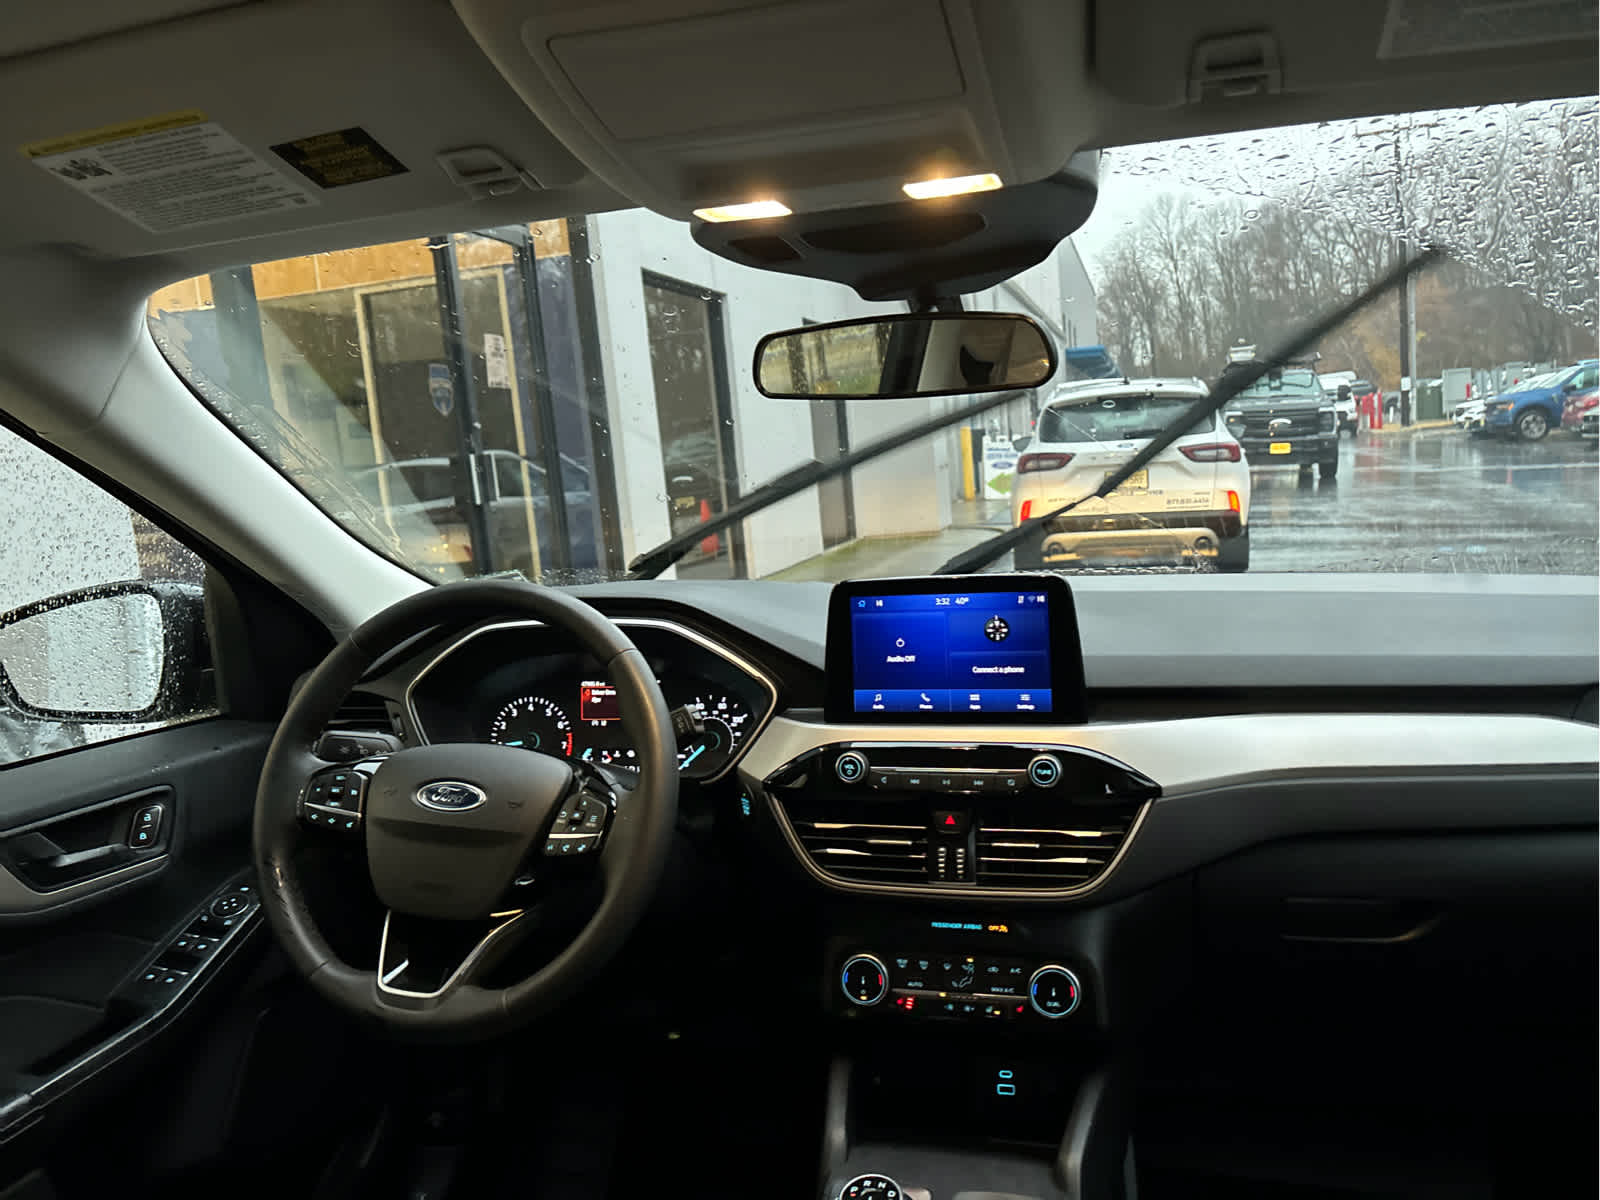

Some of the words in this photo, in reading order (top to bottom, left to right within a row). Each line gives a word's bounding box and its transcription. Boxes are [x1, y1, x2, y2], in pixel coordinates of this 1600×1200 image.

[935, 597, 950, 606] 3:32
[886, 655, 904, 663] Audio
[904, 655, 916, 663] Off
[972, 665, 998, 674] Connect
[1004, 665, 1025, 675] phone
[527, 703, 534, 712] 4
[511, 708, 518, 717] 3
[545, 708, 552, 717] 5
[500, 721, 507, 730] 2
[557, 720, 564, 730] 6
[560, 741, 567, 750] 7
[907, 980, 923, 988] AUTO
[850, 1185, 859, 1193] P
[863, 1179, 872, 1187] R
[877, 1181, 887, 1189] N
[887, 1189, 897, 1198] D
